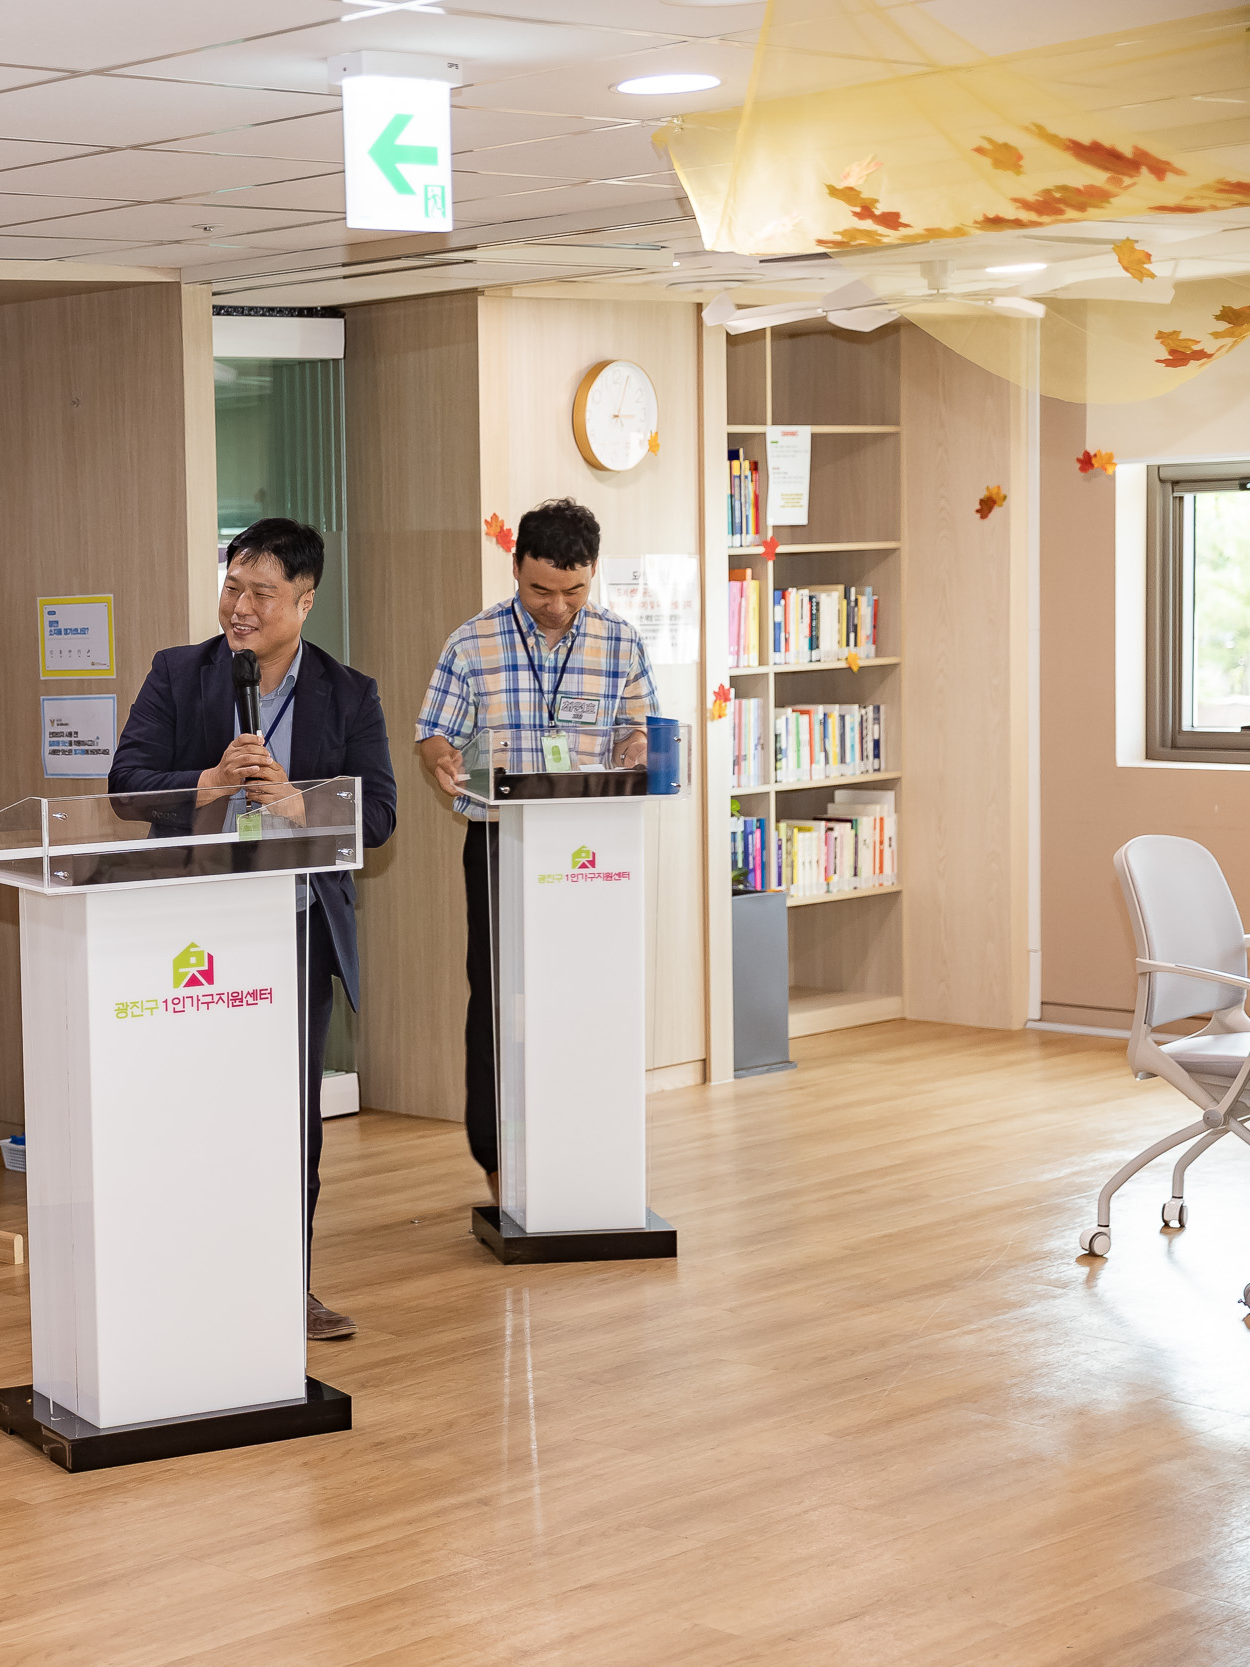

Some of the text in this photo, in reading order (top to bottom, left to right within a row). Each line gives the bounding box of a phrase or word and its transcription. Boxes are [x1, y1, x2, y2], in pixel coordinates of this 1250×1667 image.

[537, 871, 631, 884] 광진구 1인가구지원센터
[114, 987, 273, 1019] 광진구 1인가구지원센터
